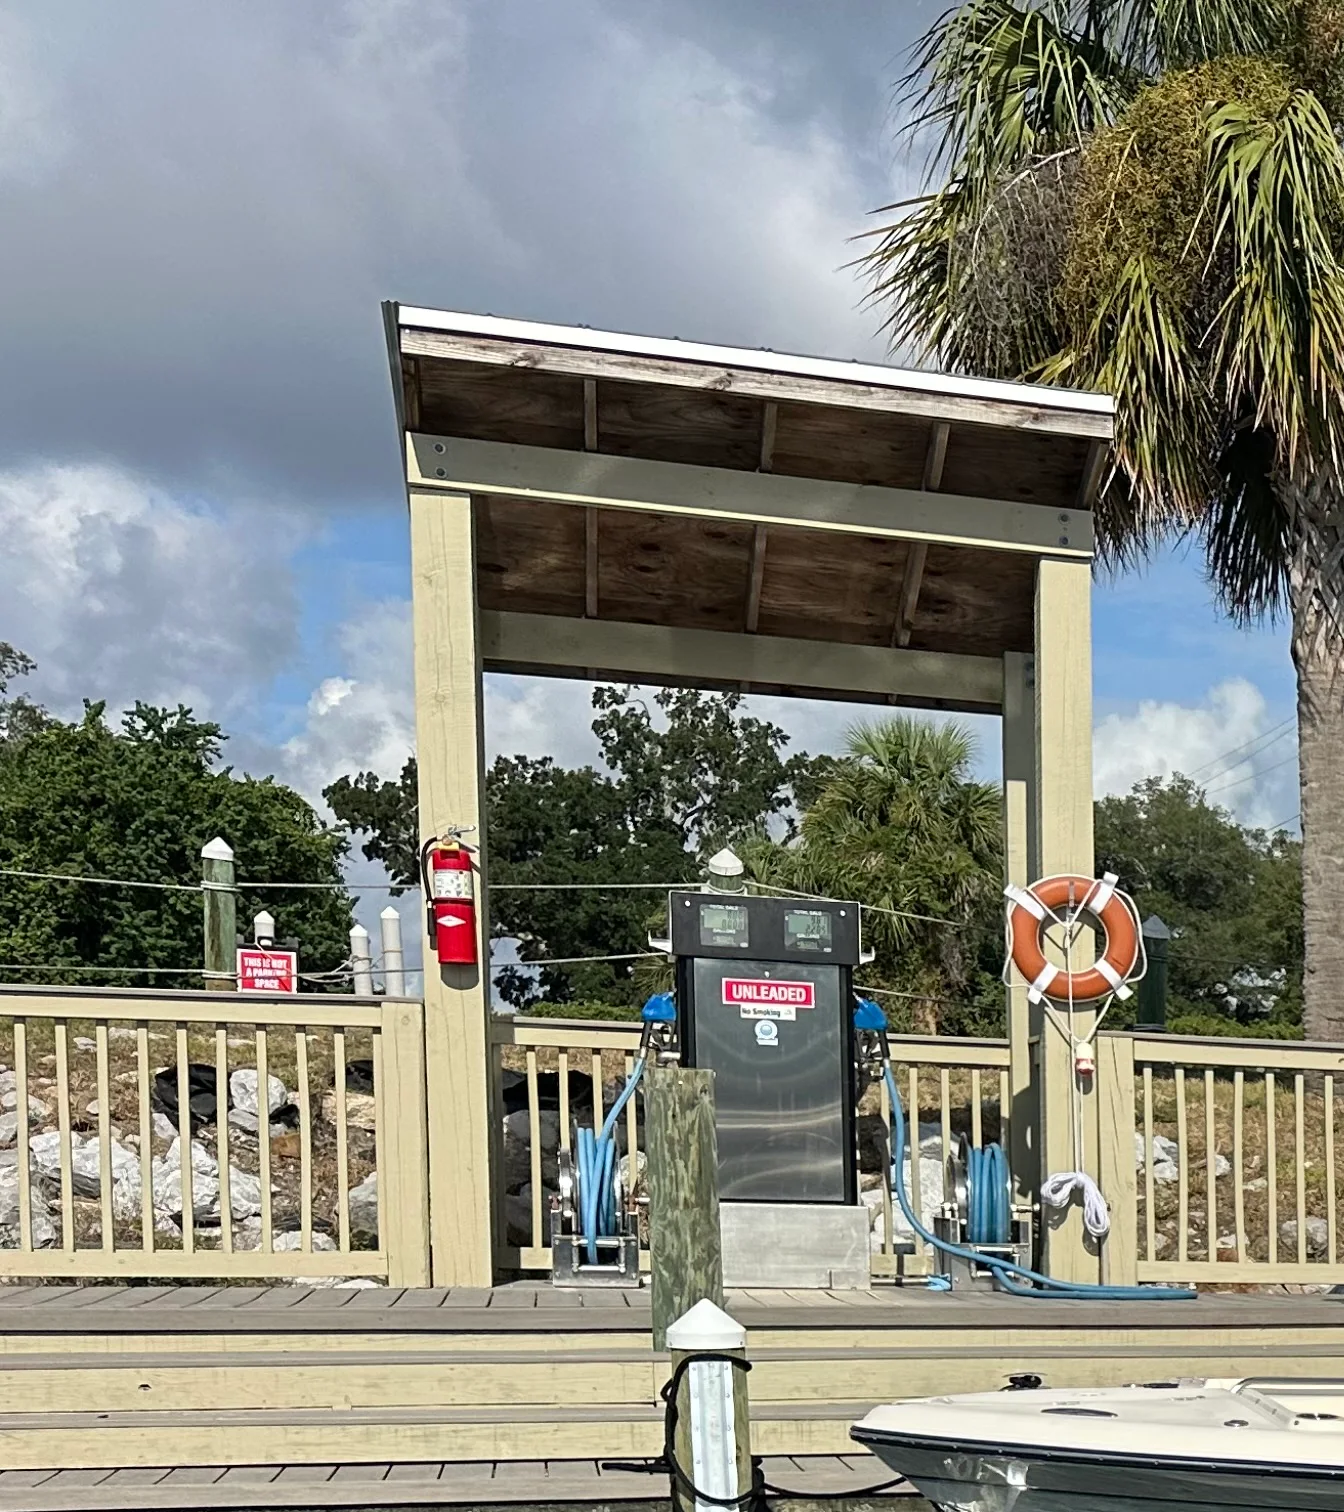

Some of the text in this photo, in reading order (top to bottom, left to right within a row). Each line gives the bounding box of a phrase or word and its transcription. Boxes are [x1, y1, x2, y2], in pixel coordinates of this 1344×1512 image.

[244, 957, 287, 968] THIS IS NOT
[246, 967, 253, 977] A
[254, 978, 280, 989] SPACE
[732, 984, 806, 1002] UNLEADED
[742, 1007, 781, 1018] No Smoking
